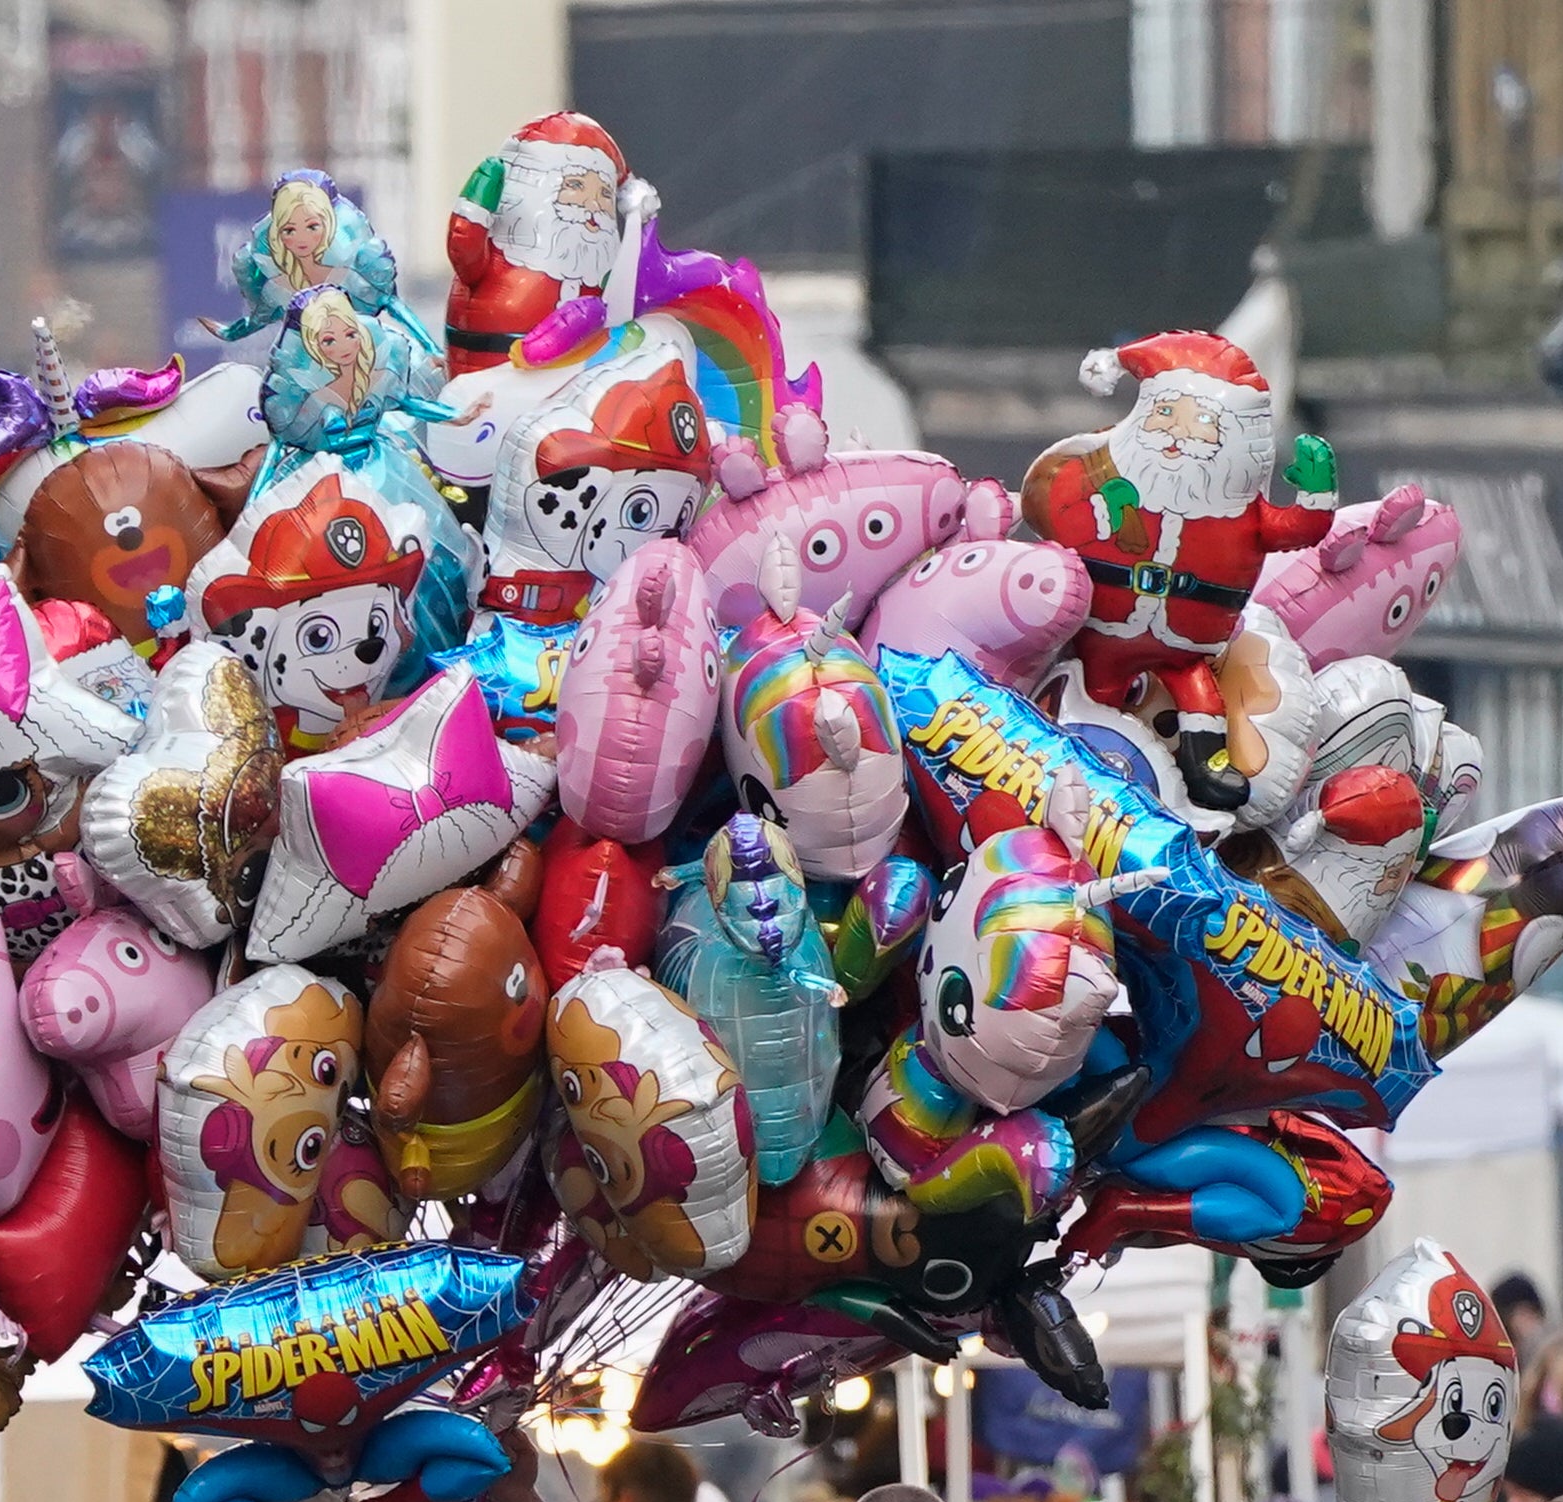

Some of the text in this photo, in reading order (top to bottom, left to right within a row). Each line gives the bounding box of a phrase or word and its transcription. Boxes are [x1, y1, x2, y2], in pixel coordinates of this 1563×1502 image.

[908, 700, 1133, 878] SPIDER-N
[1009, 738, 1135, 827] AMING
[1203, 902, 1395, 1079] SPIDER-MAN
[188, 1299, 451, 1415] SPIDER-MAN
[194, 1287, 421, 1353] THE AMAZING
[253, 1400, 286, 1415] MARVEL
